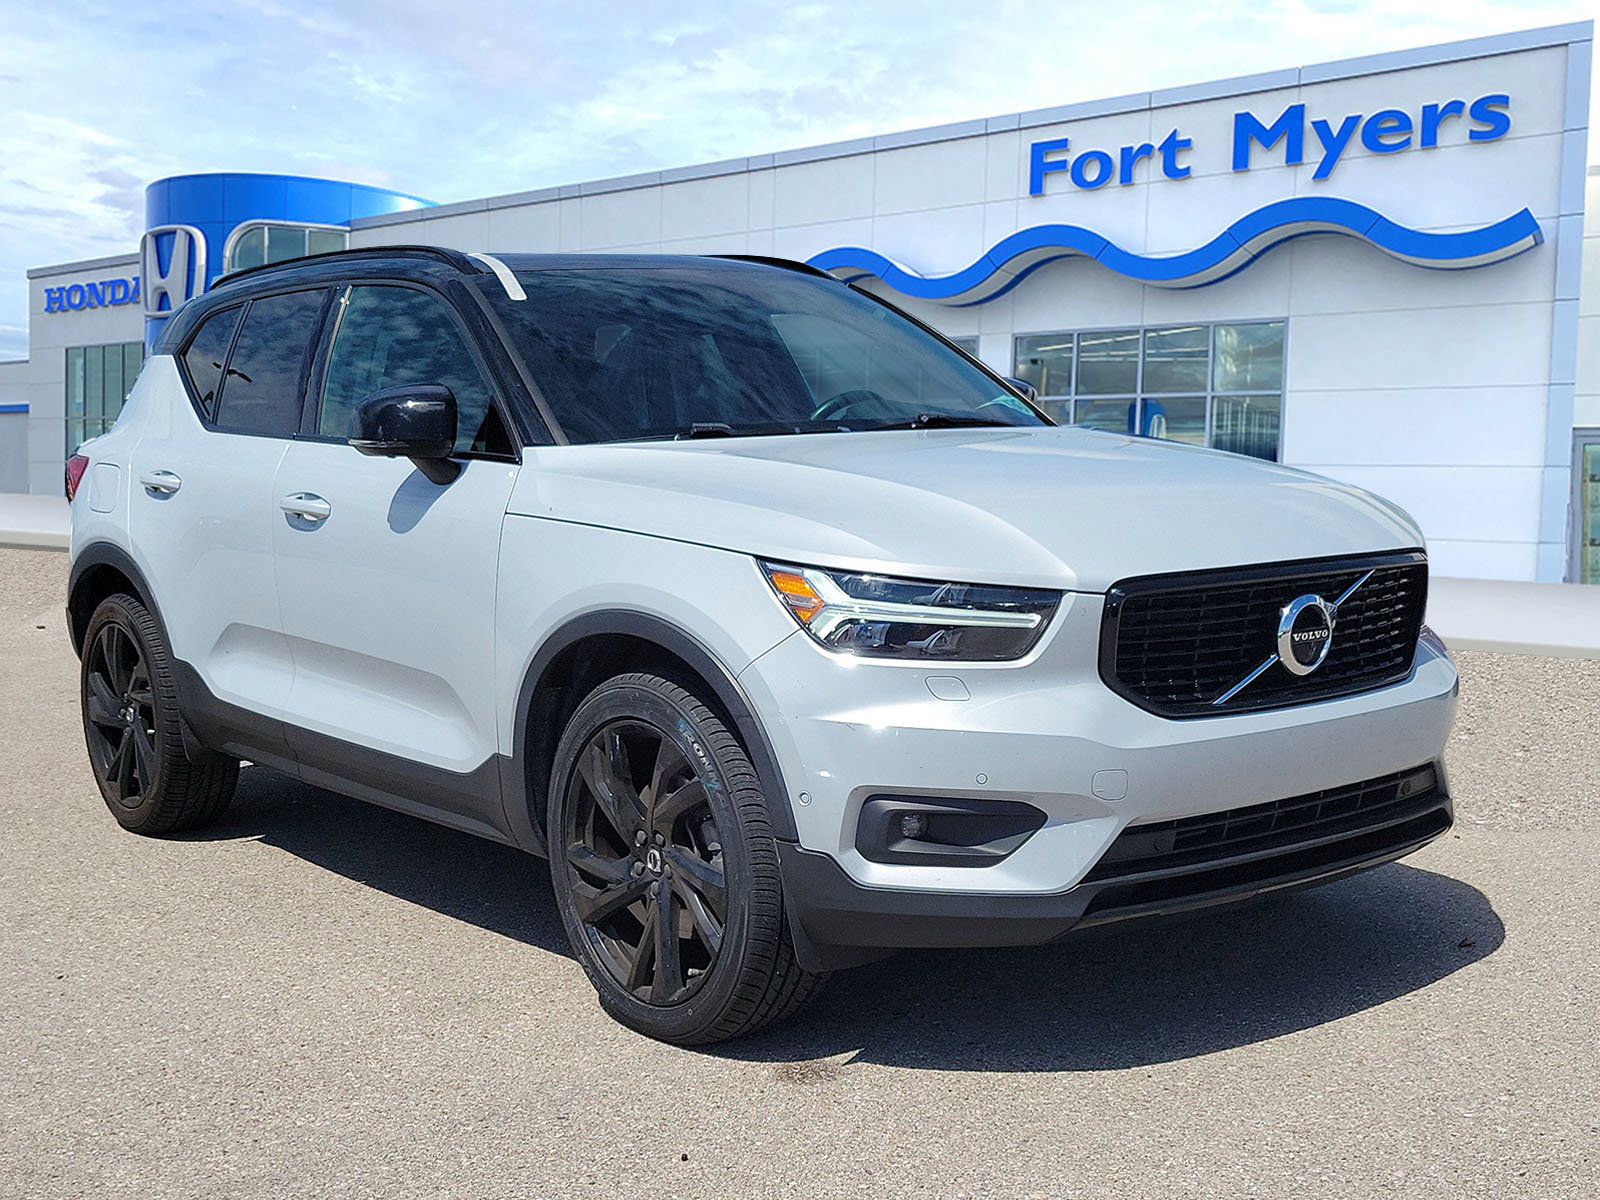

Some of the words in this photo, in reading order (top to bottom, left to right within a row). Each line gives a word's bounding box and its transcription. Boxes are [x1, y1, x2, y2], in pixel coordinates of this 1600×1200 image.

[1029, 128, 1193, 197] Fort
[1232, 93, 1511, 182] Myers
[1293, 630, 1328, 641] VOLVO
